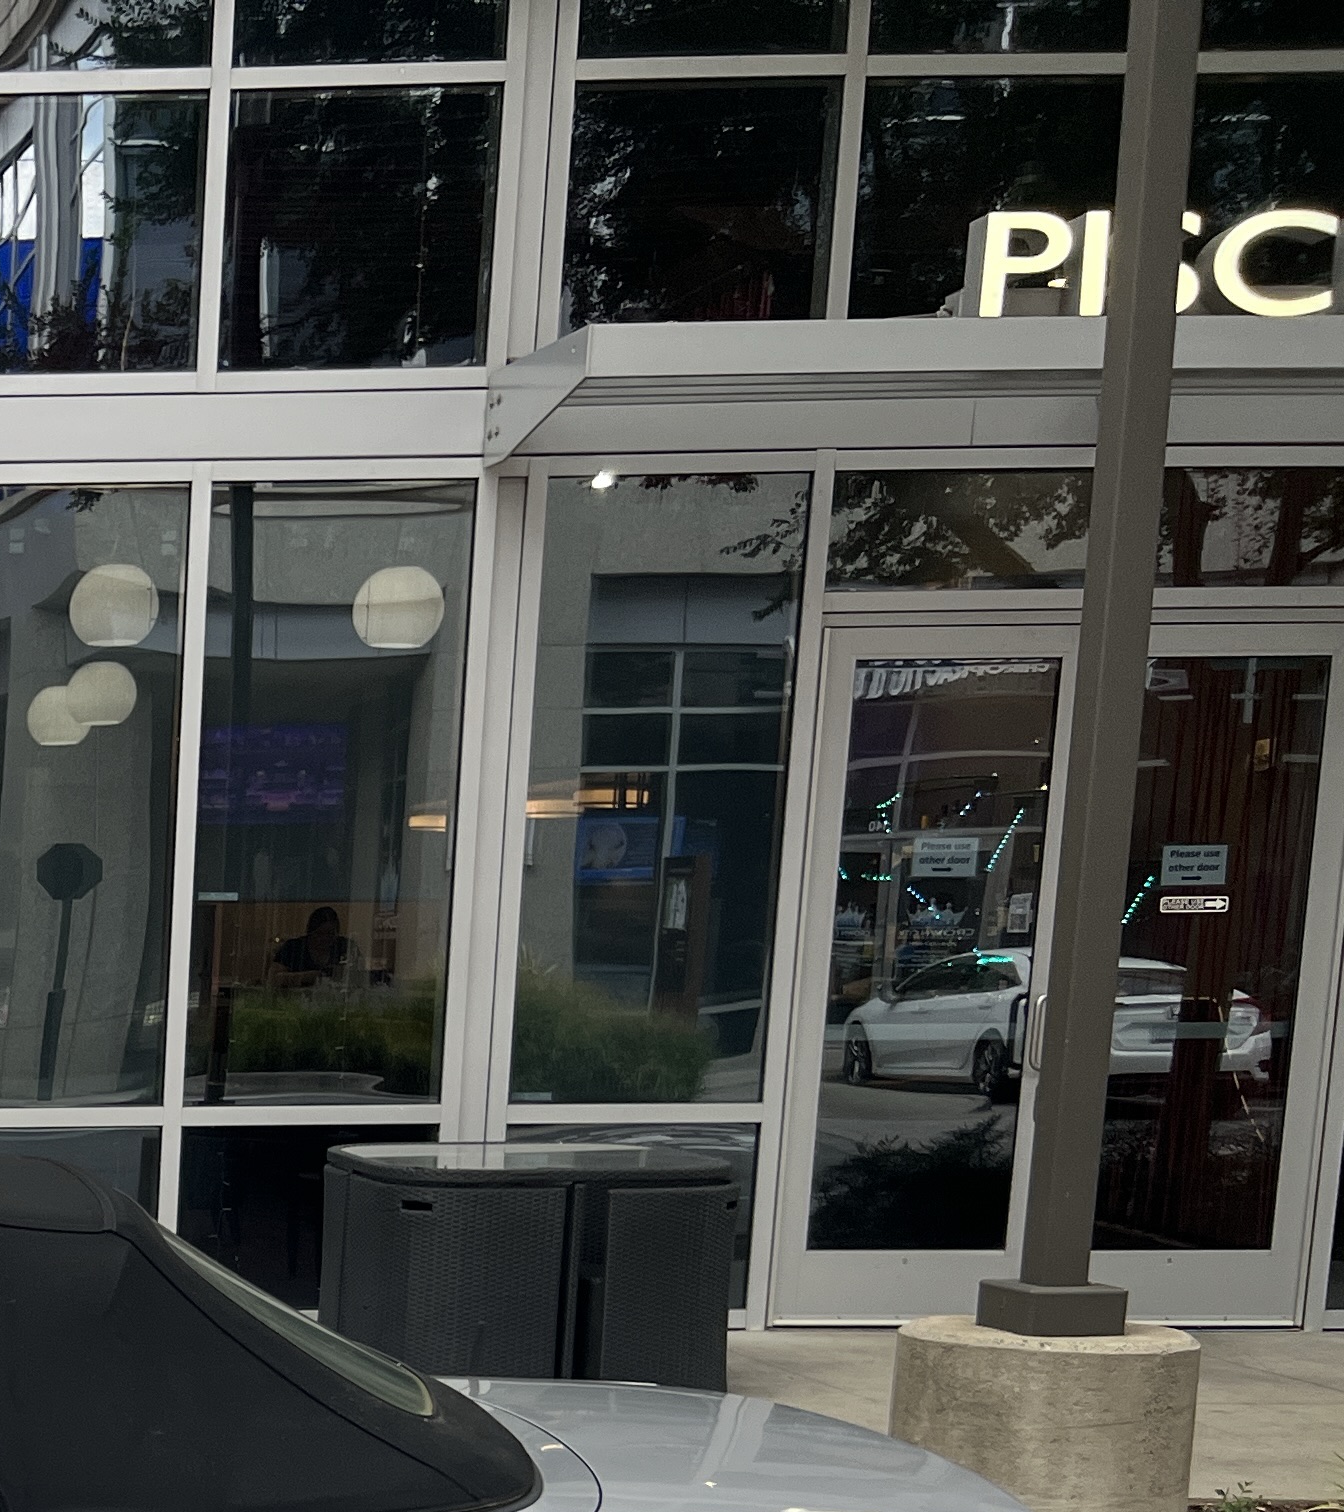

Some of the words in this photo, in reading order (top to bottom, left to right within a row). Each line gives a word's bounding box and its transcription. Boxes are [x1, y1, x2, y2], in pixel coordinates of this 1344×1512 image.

[920, 842, 951, 850] Please
[1170, 850, 1201, 858] Please
[918, 856, 945, 864] other
[947, 855, 970, 864] door
[1168, 864, 1195, 872] other
[1197, 863, 1220, 871] door
